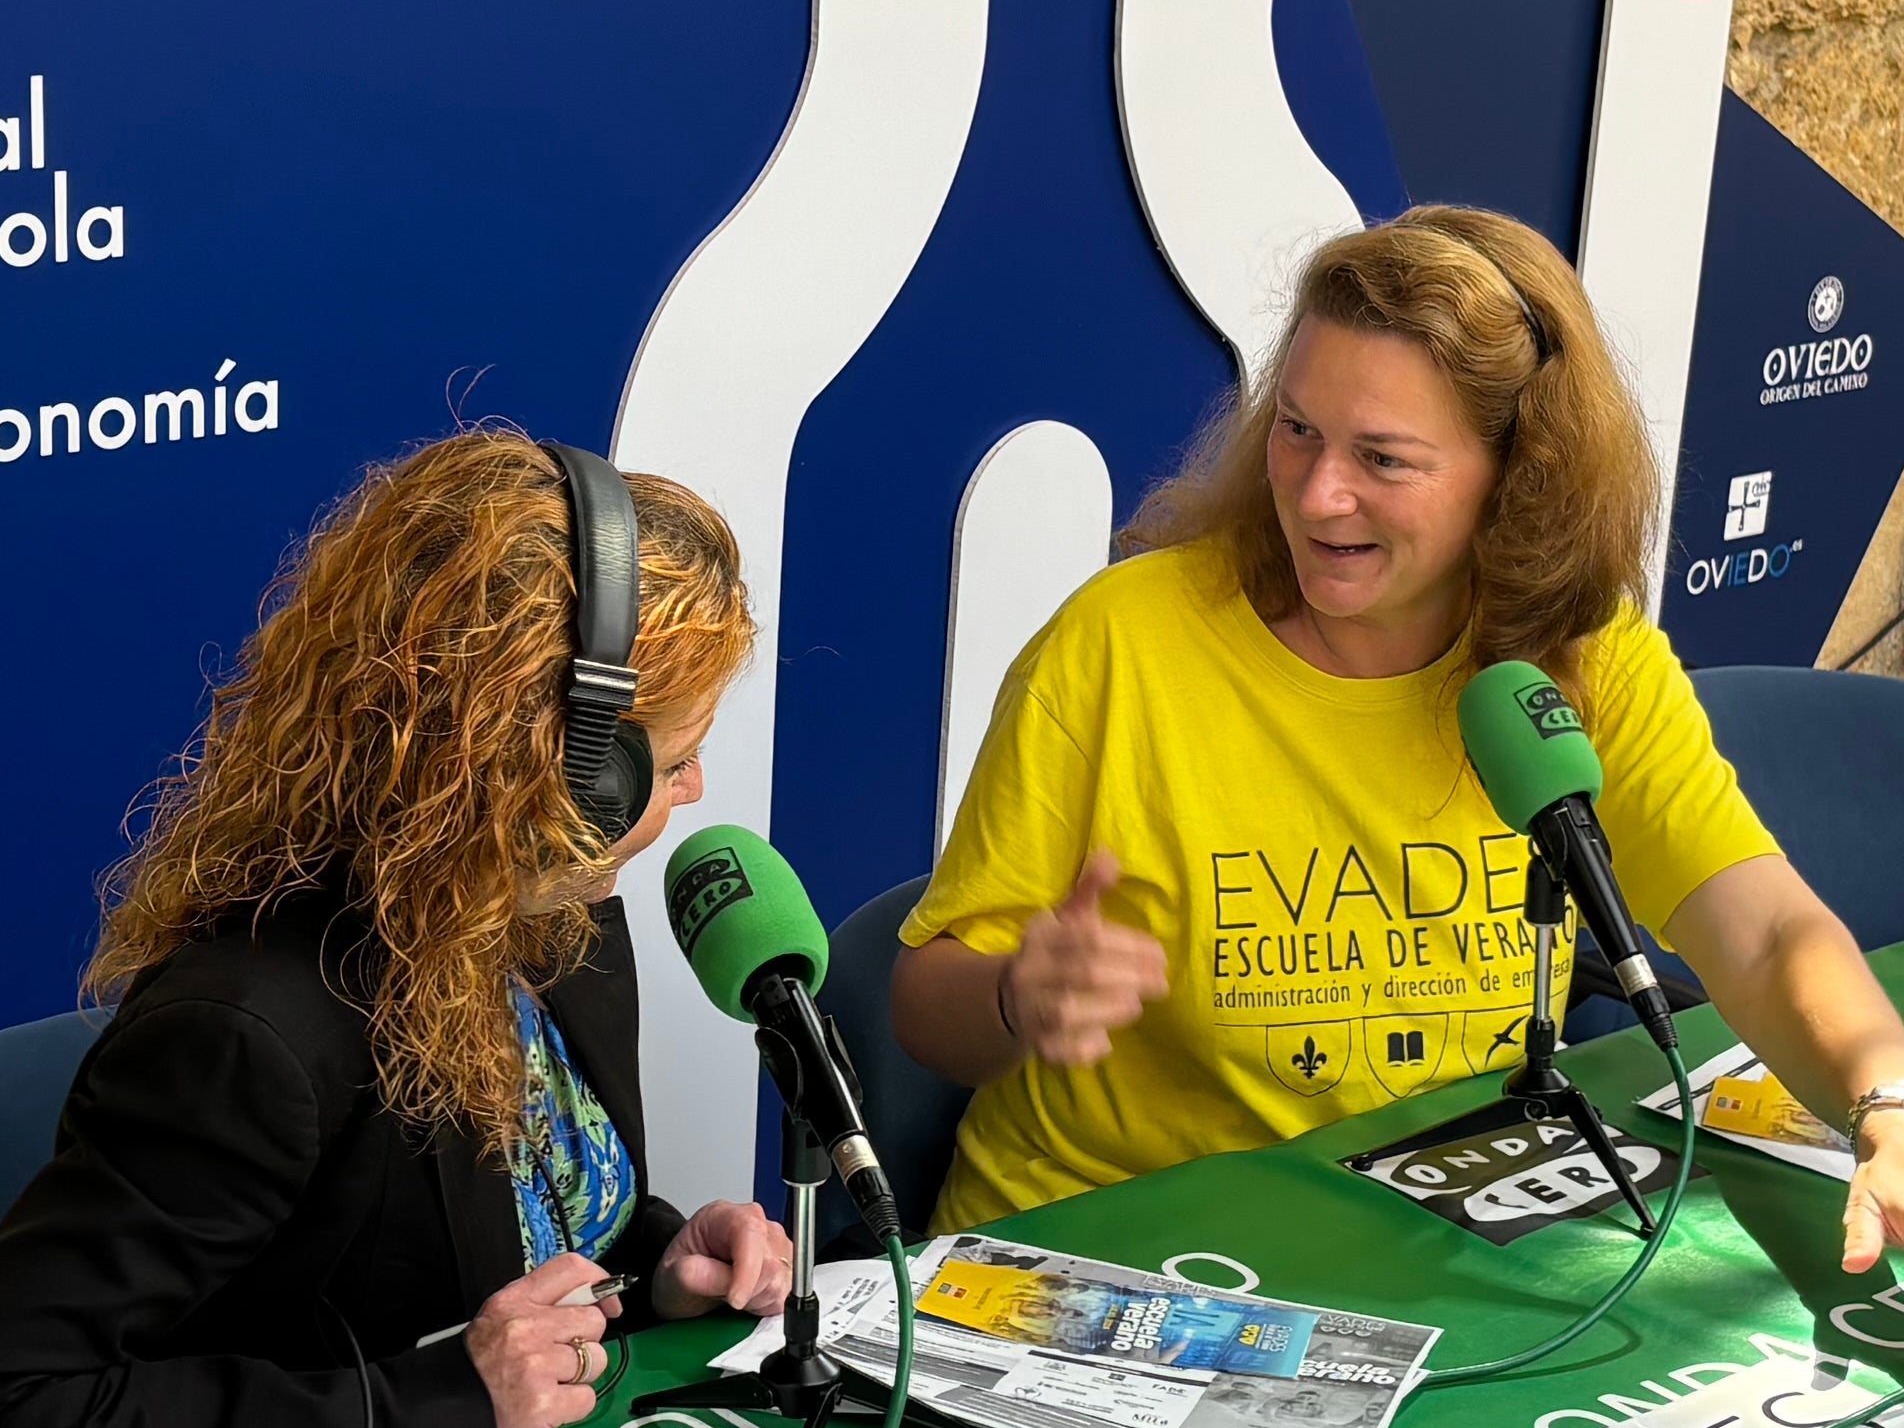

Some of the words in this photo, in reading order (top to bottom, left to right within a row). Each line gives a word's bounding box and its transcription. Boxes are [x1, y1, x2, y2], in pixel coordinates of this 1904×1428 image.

[1763, 333, 1873, 386] OVIEDO
[1760, 383, 1800, 406] ORIGEN
[1802, 378, 1822, 398] DEL
[1824, 372, 1868, 395] CAMINO
[1211, 832, 1536, 930] EVADE
[682, 881, 732, 937] CERO
[1213, 924, 1364, 979] ESCUELA
[1386, 923, 1429, 968] DE
[1213, 978, 1350, 1009] administración
[1361, 982, 1371, 1007] y
[1384, 971, 1467, 1000] dirección
[1480, 970, 1501, 993] de
[1404, 1124, 1575, 1185] ONDA
[1111, 1302, 1147, 1352] verano
[1133, 1297, 1171, 1350] escuela
